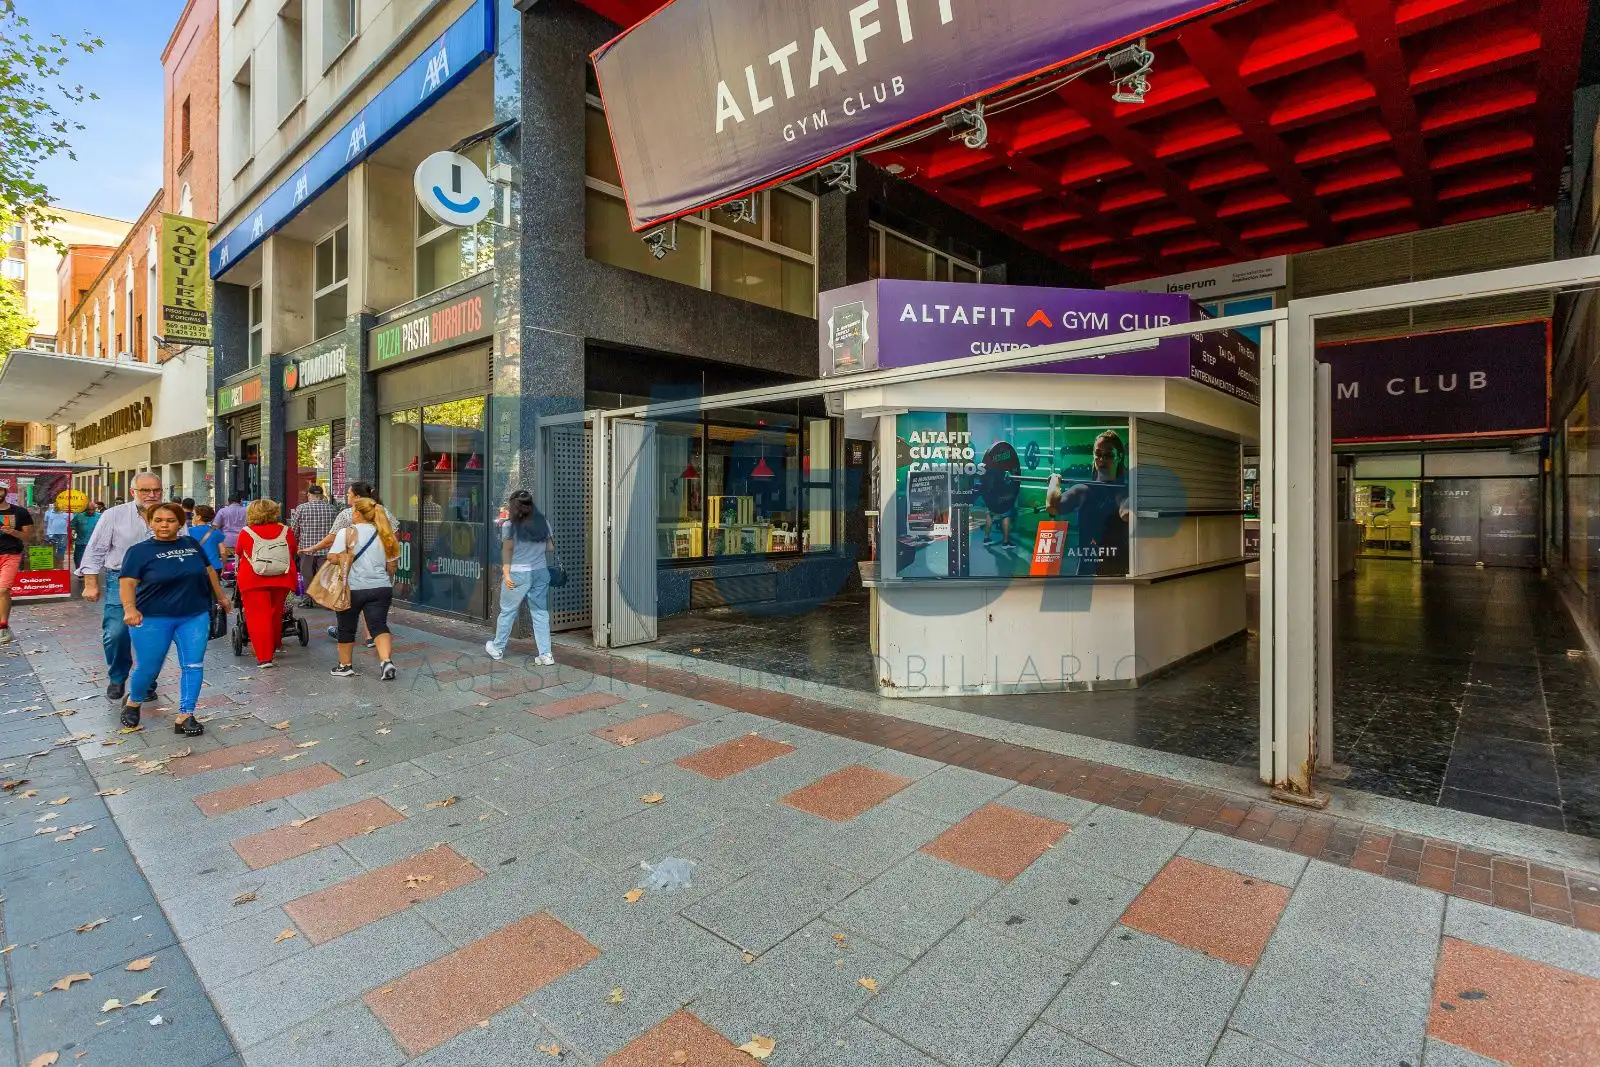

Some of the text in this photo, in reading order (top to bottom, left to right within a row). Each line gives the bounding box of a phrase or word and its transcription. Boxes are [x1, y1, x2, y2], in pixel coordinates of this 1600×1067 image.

[420, 48, 450, 100] AXA
[783, 75, 905, 142] GYM CLUB
[171, 225, 197, 309] ALQUILER
[377, 296, 482, 361] PIZZA PASTA BURRITOS
[900, 303, 1016, 327] ALTAFIT
[1062, 311, 1108, 330] GYM
[1386, 371, 1488, 396] CLUB
[909, 430, 972, 444] ALTAFIT
[909, 446, 975, 460] CUATRO
[909, 462, 987, 476] CAMINOS
[1068, 547, 1117, 556] ALTAFIT
[438, 557, 481, 580] POMODORO
